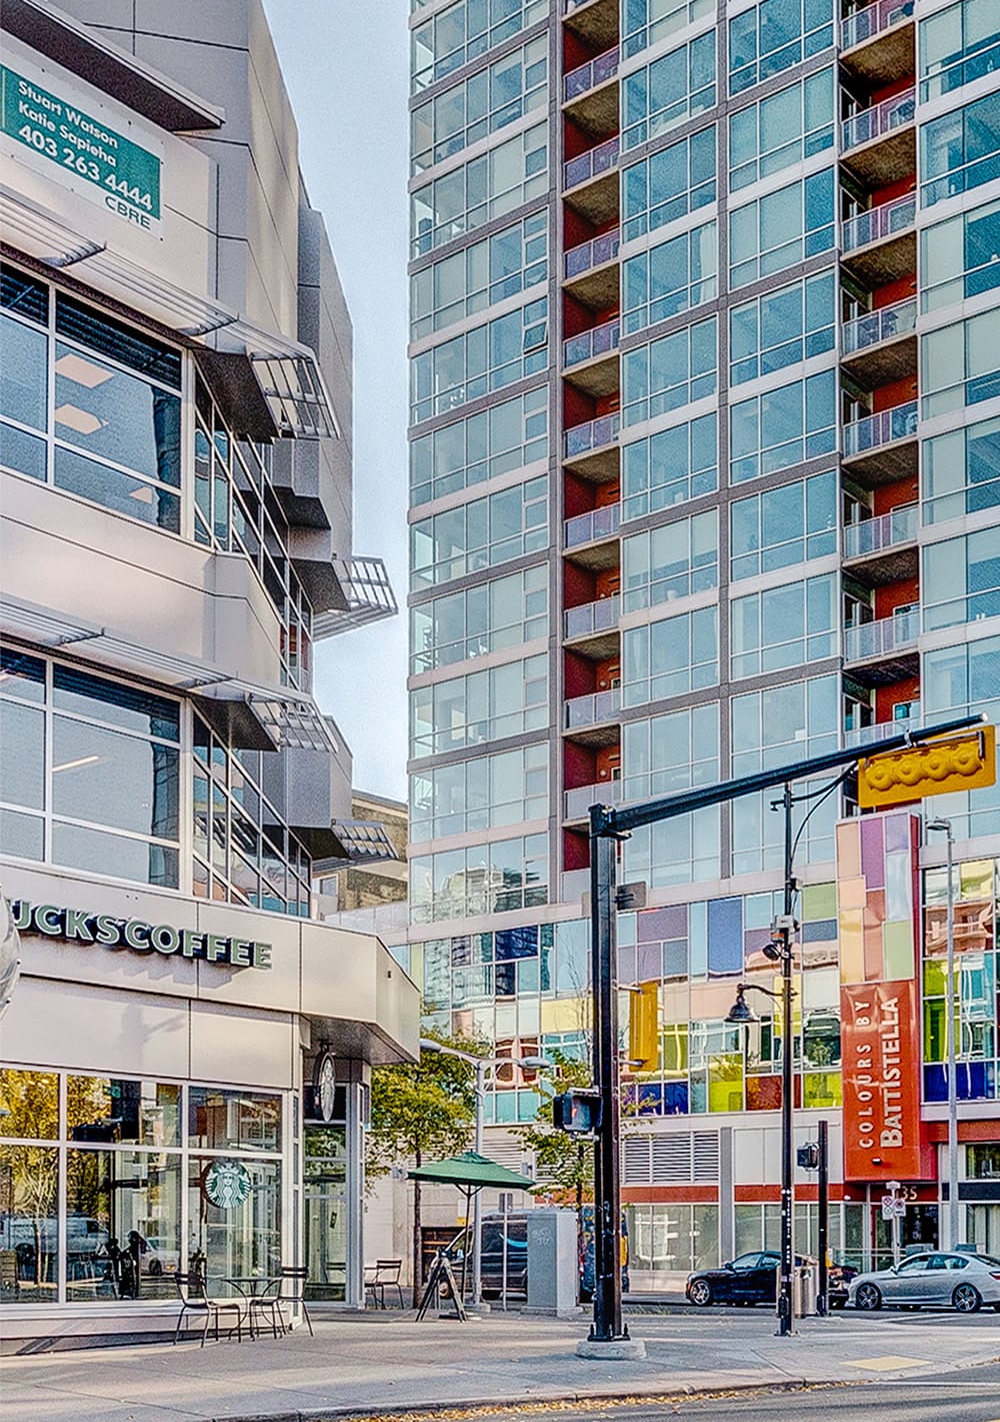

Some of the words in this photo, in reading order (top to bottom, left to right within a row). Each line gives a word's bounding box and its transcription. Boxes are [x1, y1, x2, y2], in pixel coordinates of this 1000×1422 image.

[18, 80, 63, 116] Stuart
[66, 107, 119, 150] Watson
[18, 100, 57, 133] Katie
[59, 124, 118, 168] Sapieha
[18, 125, 59, 158] 403
[63, 147, 101, 181] 263
[104, 173, 153, 211] 4444
[104, 194, 152, 231] CBRE
[854, 1000, 871, 1028] BY
[856, 1043, 875, 1149] COLOURS
[879, 996, 904, 1148] BATTISTELLA
